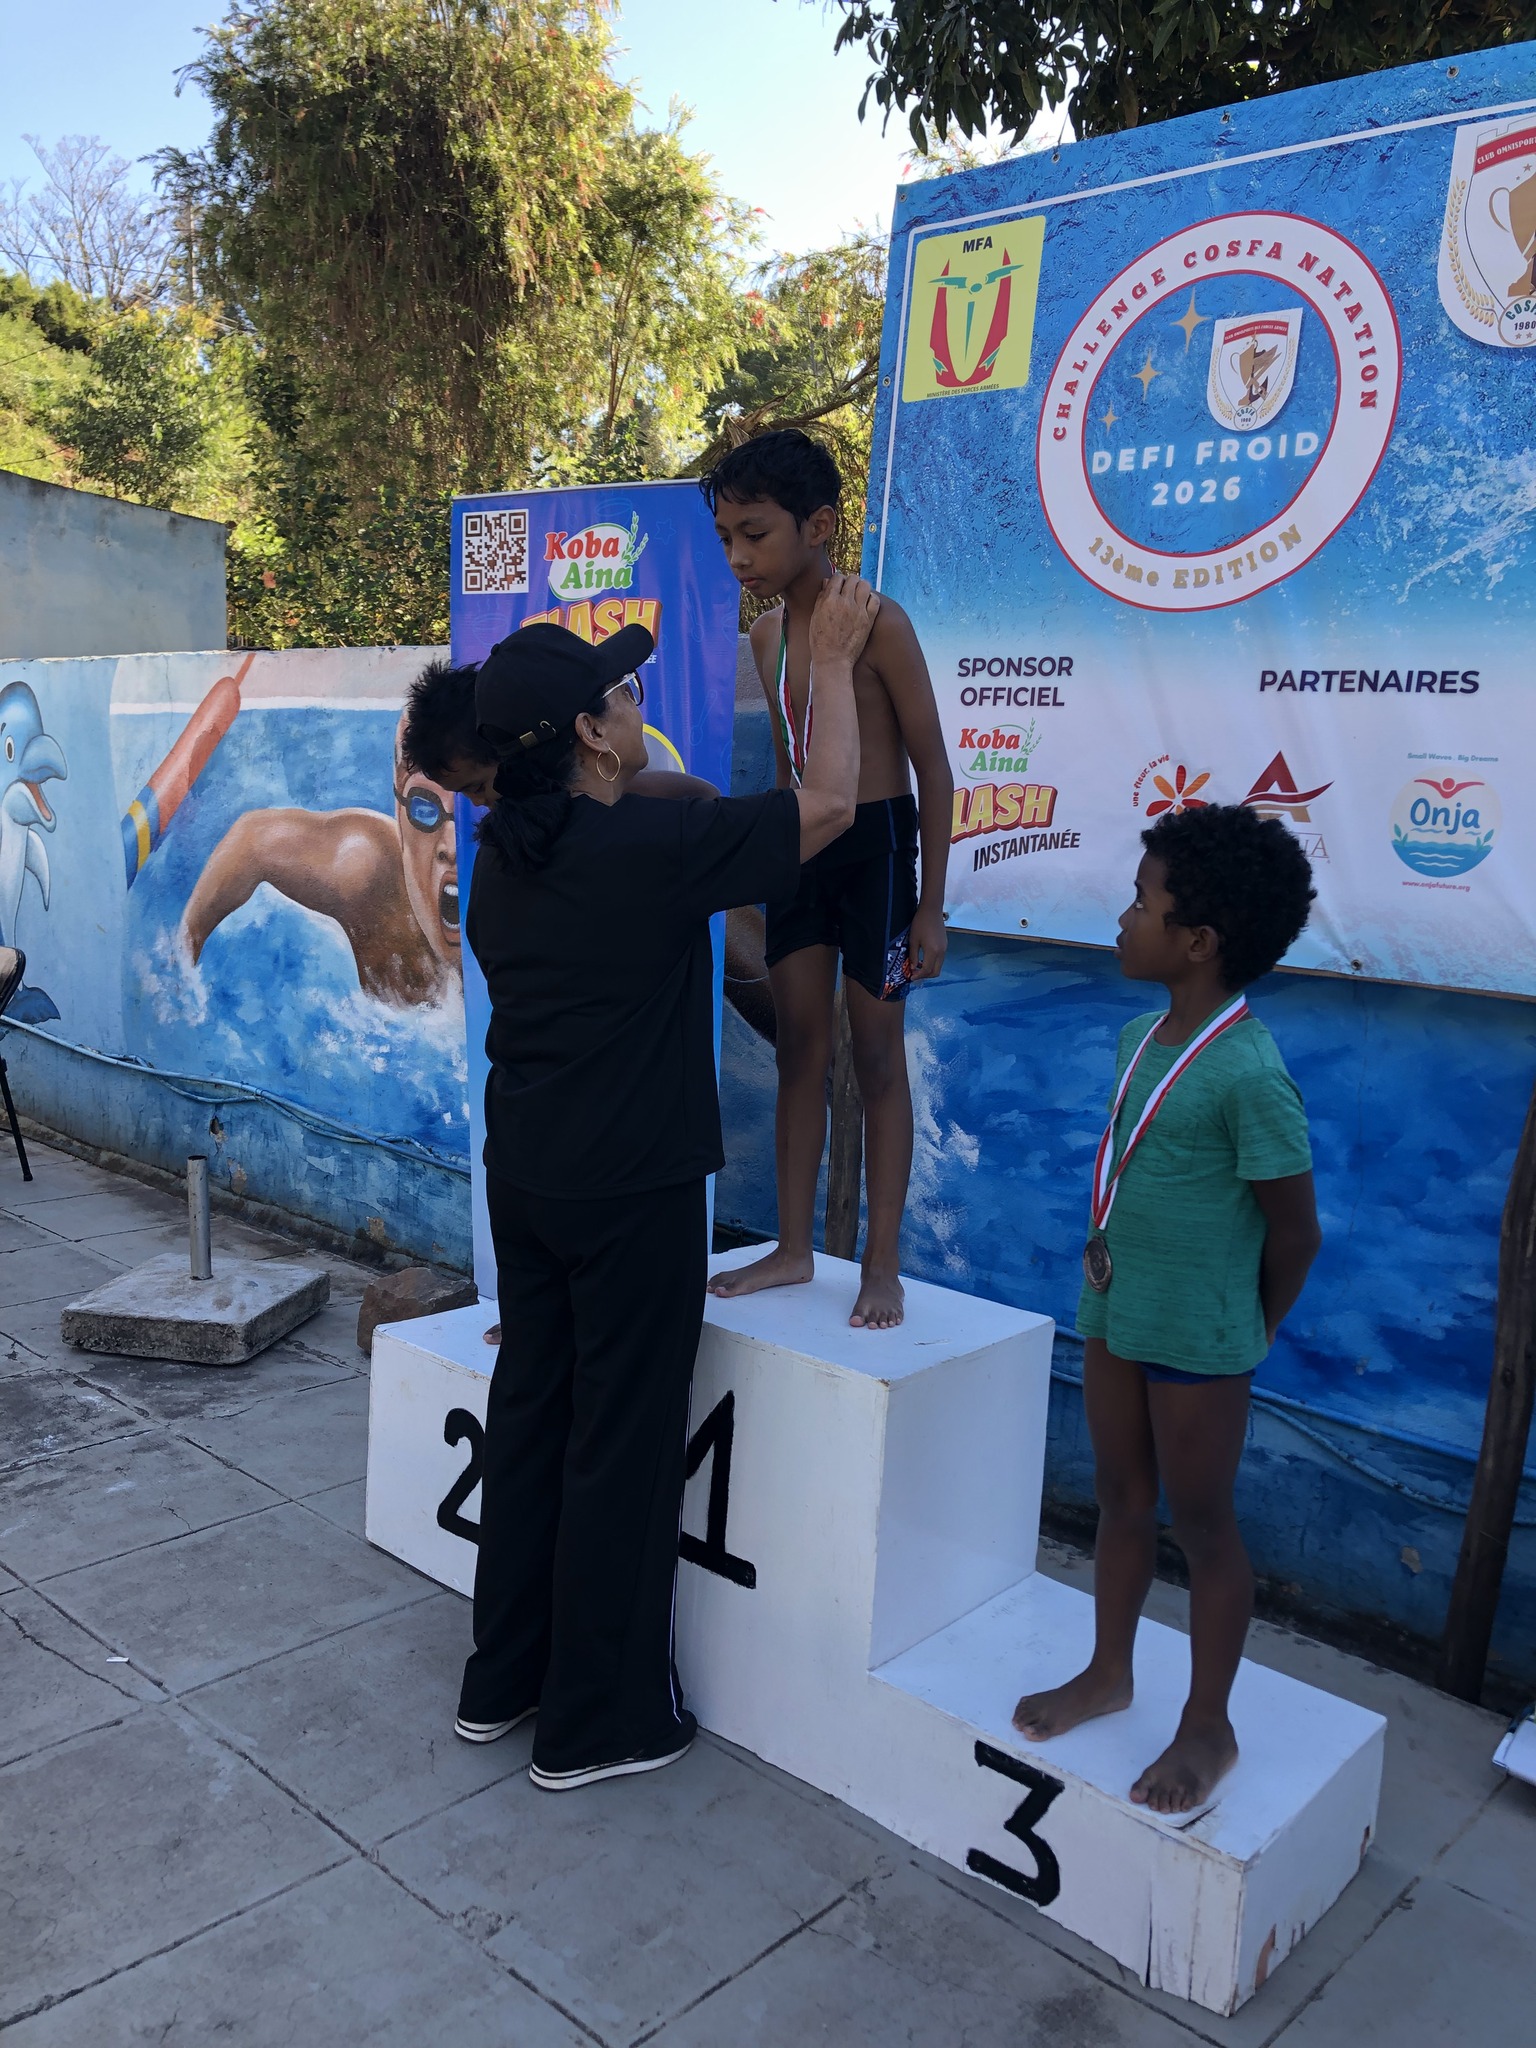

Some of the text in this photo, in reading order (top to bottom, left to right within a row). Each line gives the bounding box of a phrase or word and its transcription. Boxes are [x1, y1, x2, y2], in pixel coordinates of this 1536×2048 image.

[1477, 151, 1495, 164] CLUB
[962, 235, 993, 253] MFA
[1053, 239, 1379, 441] CHALLENGE COSFA NATATION
[951, 387, 961, 395] DES
[960, 385, 979, 394] FORCES
[1092, 431, 1320, 475] DEFI FROID
[1151, 475, 1242, 506] 2026
[544, 530, 620, 560] Koba
[1088, 523, 1303, 589] 13ème EDITION
[559, 560, 633, 590] Aina
[957, 656, 1074, 678] SPONSOR
[1259, 669, 1481, 694] PARTENAIRES
[960, 686, 1066, 707] OFFICIEL
[958, 727, 1021, 750] Koba
[969, 750, 1029, 773] Aina
[1457, 754, 1470, 763] Big
[1132, 791, 1140, 807] une
[1148, 760, 1158, 769] la
[1157, 754, 1170, 764] vie
[950, 782, 1058, 845] LASH
[1410, 797, 1481, 835] Onja
[973, 828, 1081, 873] INSTANTANÉE
[437, 1407, 486, 1546] 2
[677, 1389, 757, 1590] 1
[966, 1739, 1065, 1907] 3
